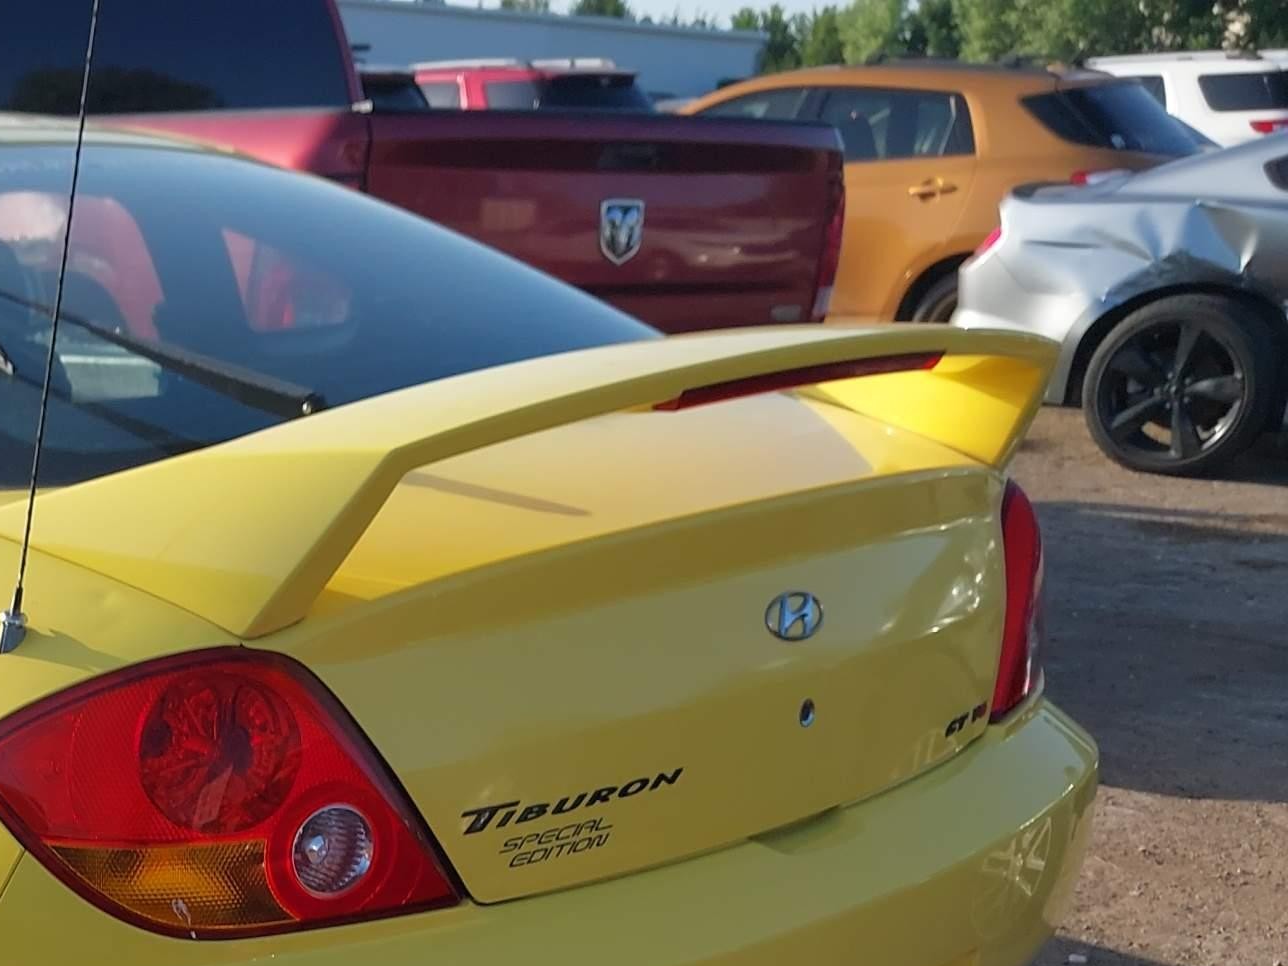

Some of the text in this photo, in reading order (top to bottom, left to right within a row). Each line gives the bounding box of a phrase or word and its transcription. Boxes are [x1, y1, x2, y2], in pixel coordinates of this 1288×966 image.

[461, 767, 684, 835] TIBURON
[499, 817, 613, 854] SPECIAL
[509, 833, 610, 868] EDITION
